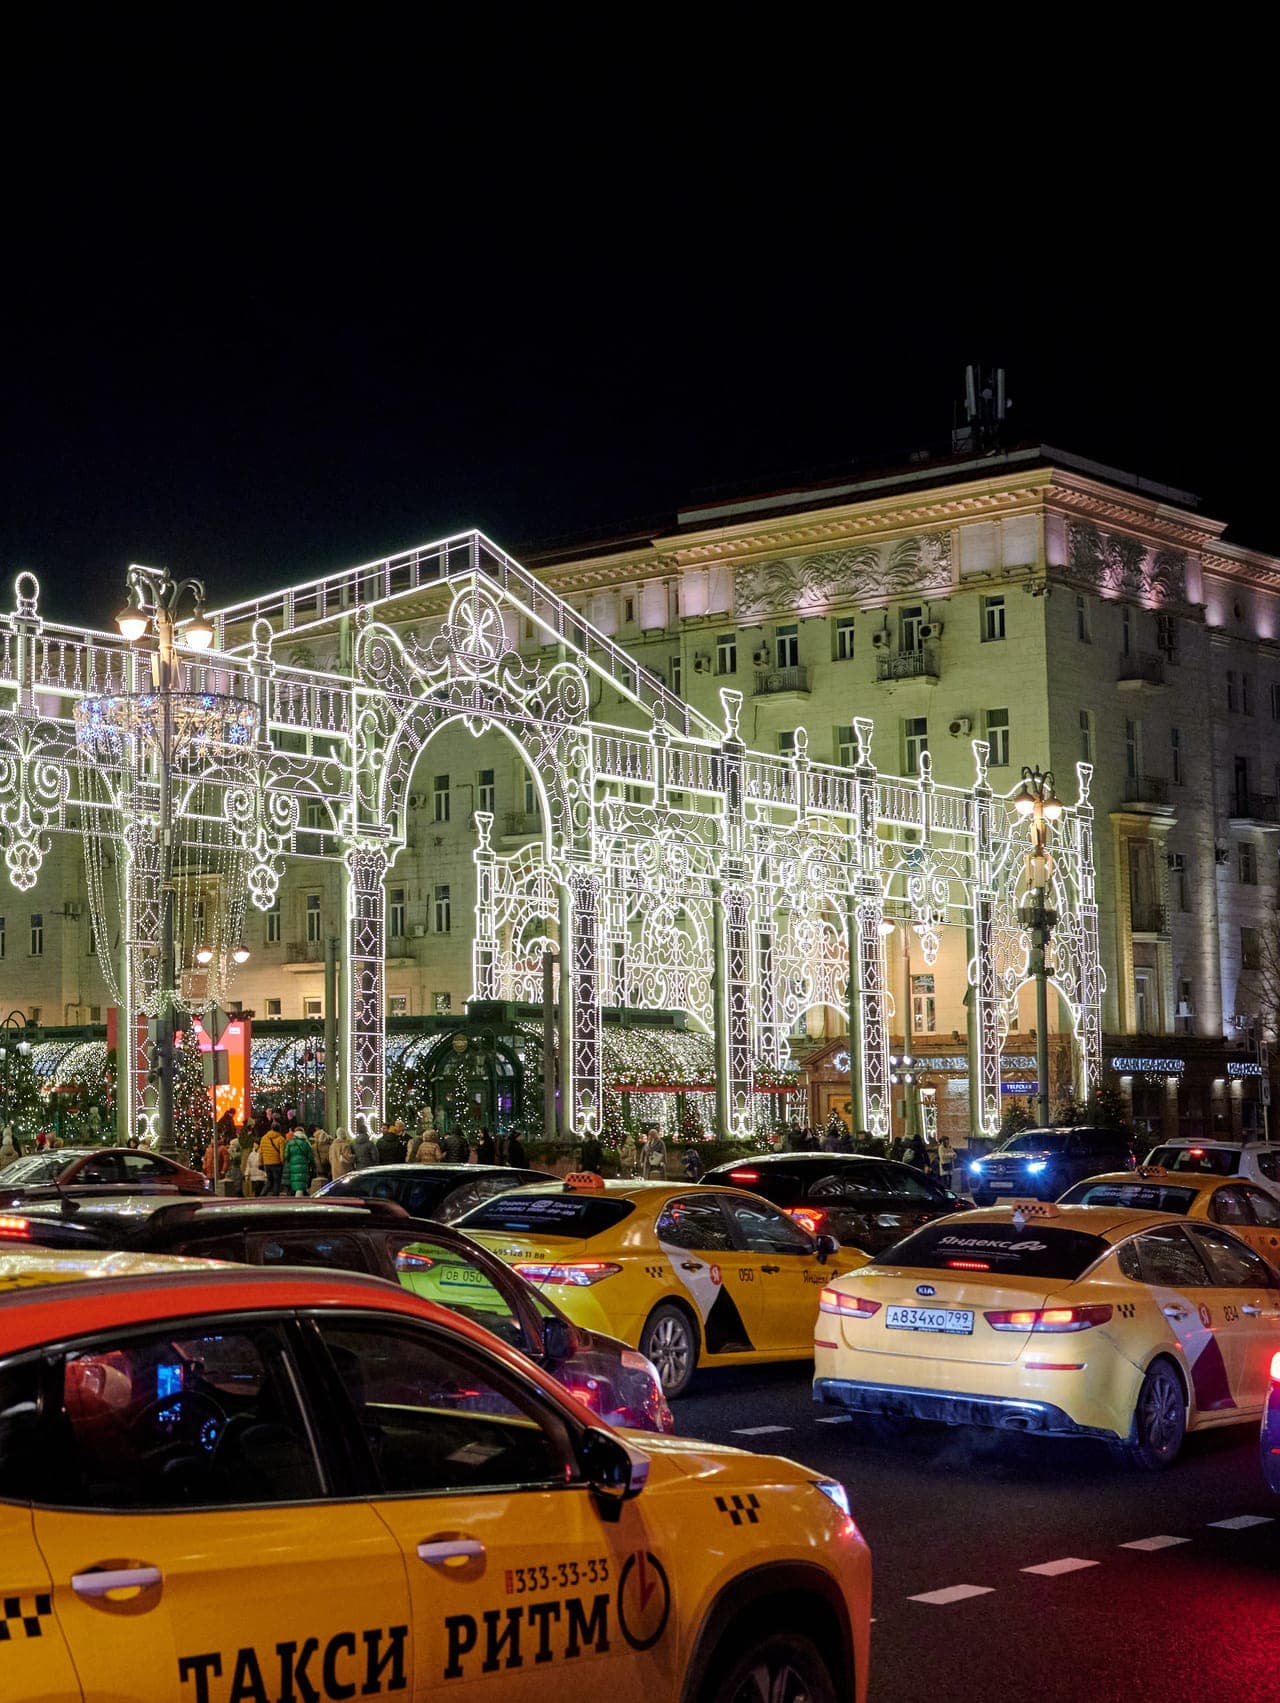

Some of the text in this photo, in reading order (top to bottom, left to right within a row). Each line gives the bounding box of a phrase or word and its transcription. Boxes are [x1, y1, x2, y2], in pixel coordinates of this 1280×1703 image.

[937, 1236, 1010, 1249] Яндекс
[917, 1287, 934, 1295] KIA
[515, 1558, 610, 1594] 333-33-33
[178, 1594, 611, 1703] ТАКСИ РИТМ
